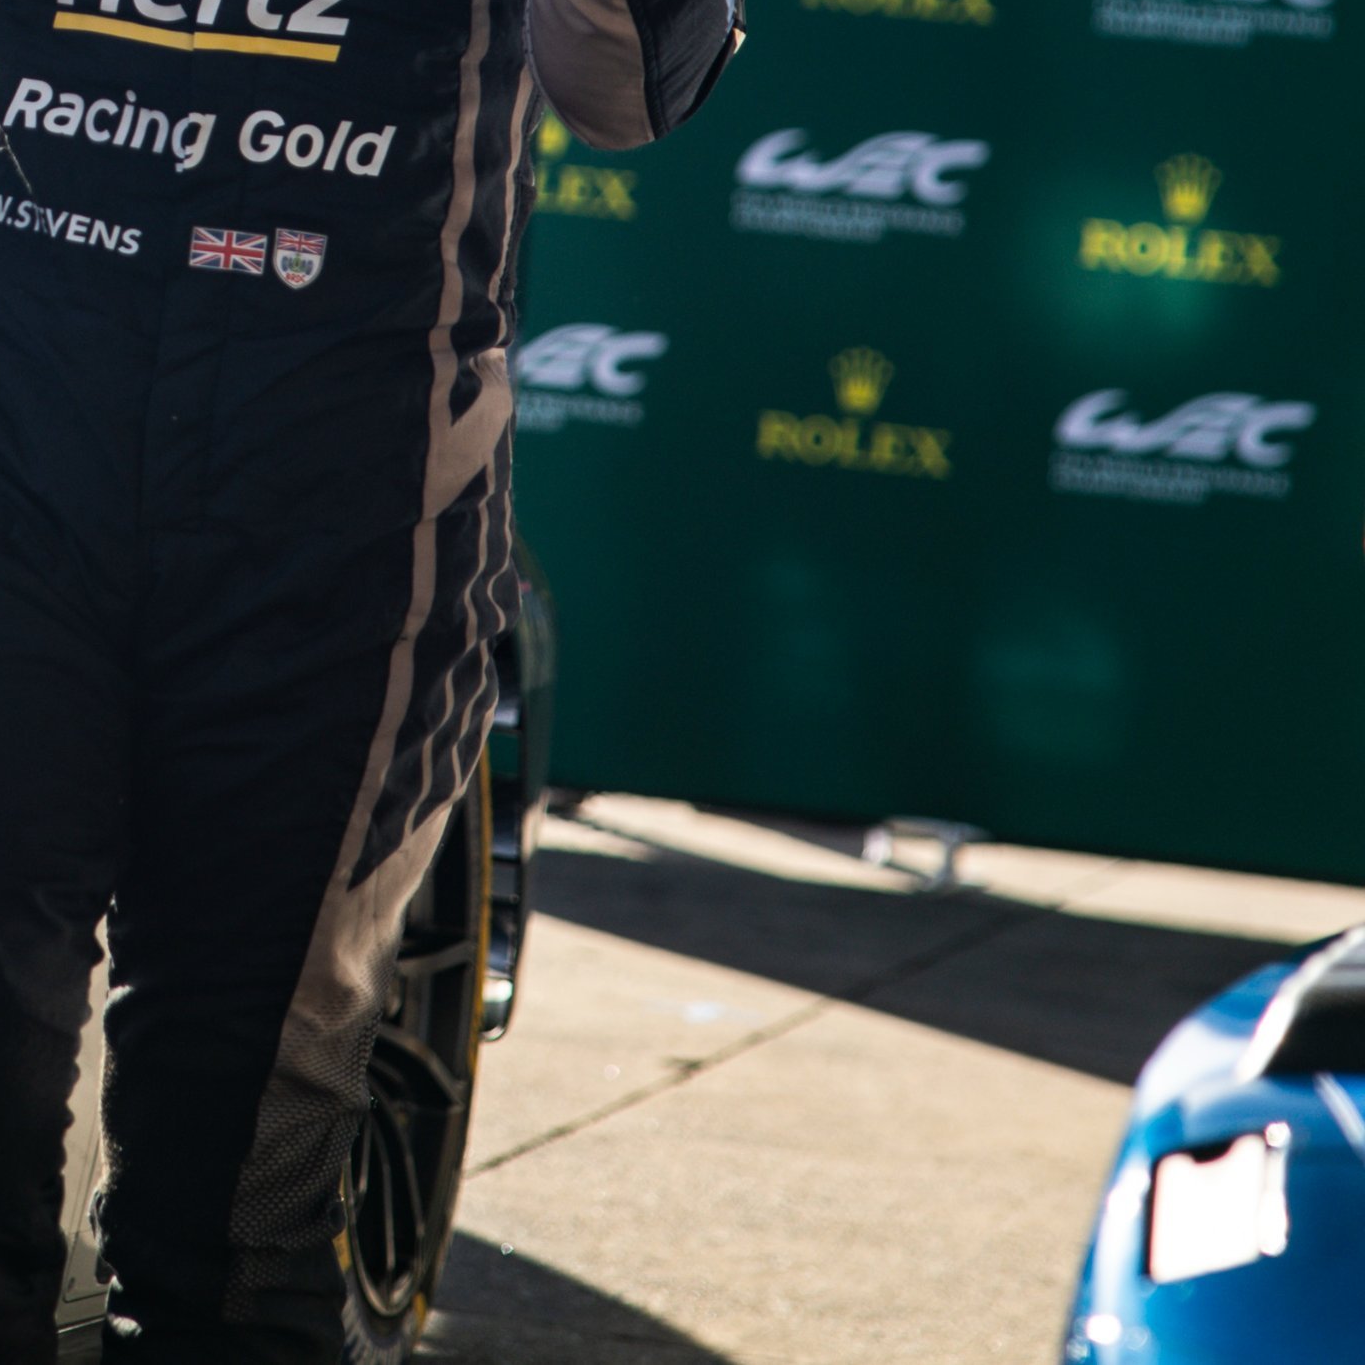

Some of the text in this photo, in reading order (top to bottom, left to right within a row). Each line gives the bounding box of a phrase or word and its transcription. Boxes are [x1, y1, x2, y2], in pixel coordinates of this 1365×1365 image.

[3, 78, 397, 178] Racing Gold
[536, 164, 638, 221] LEX
[735, 127, 991, 206] WEC
[1078, 217, 1280, 288] ROLEX
[757, 408, 954, 479] ROLEX
[1052, 388, 1315, 467] WEC
